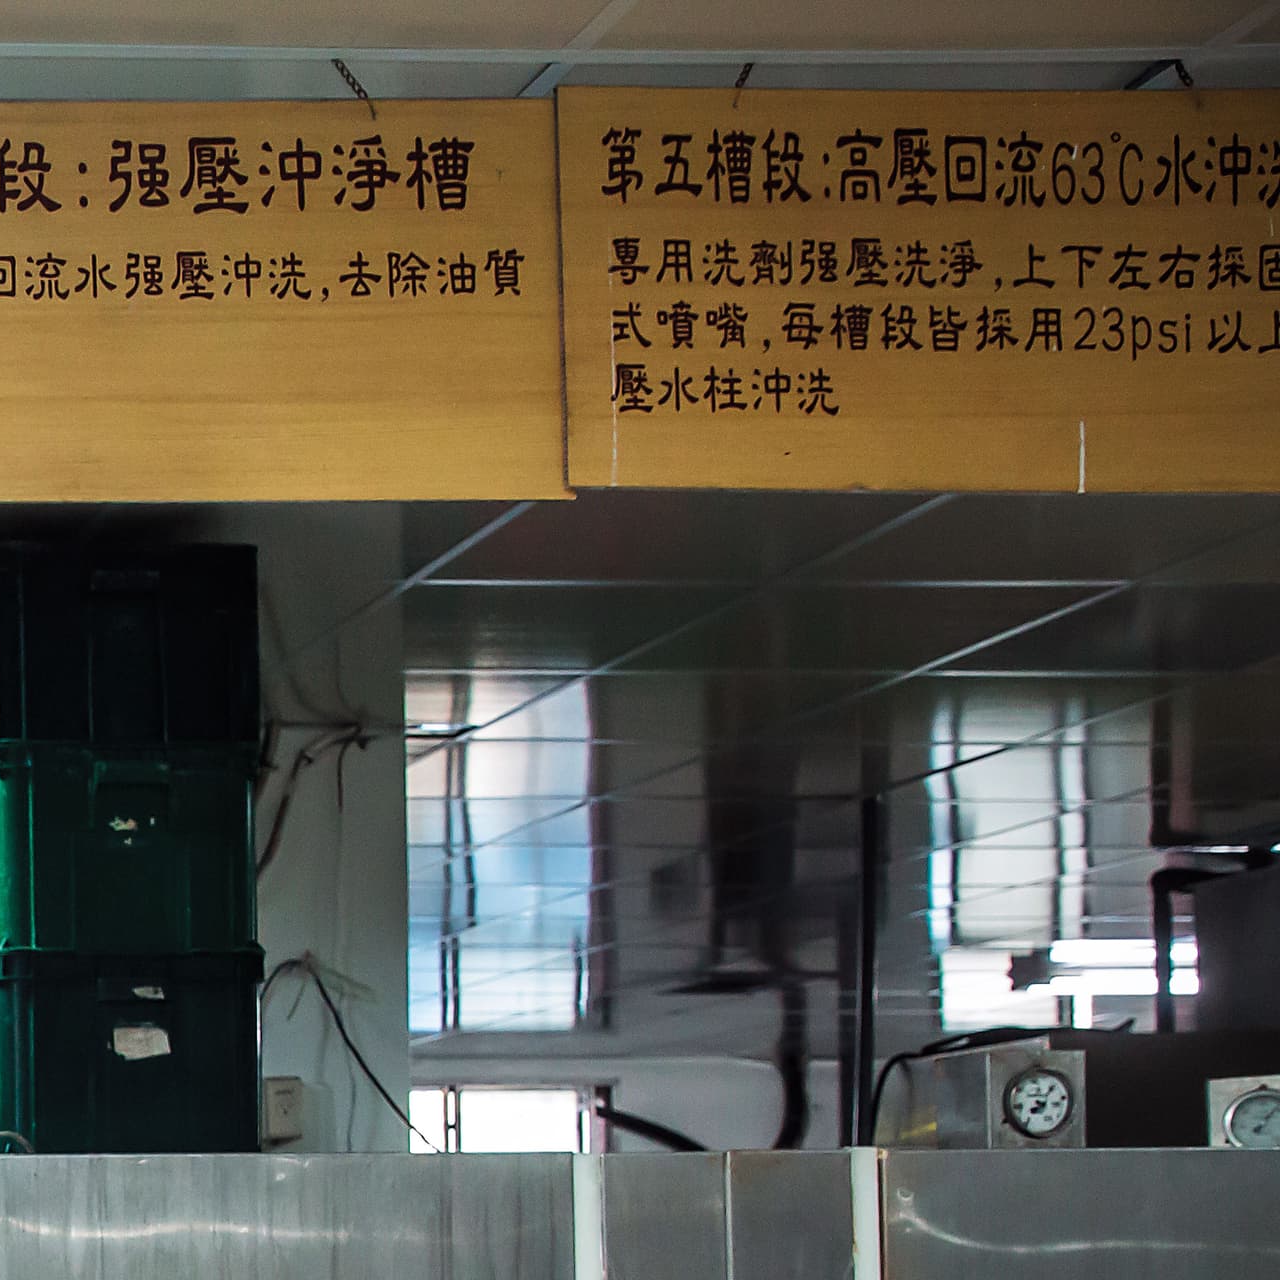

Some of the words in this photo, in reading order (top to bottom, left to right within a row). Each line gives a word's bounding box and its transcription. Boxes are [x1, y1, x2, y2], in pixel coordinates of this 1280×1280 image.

[610, 363, 840, 417] 壓水柱沖洗
